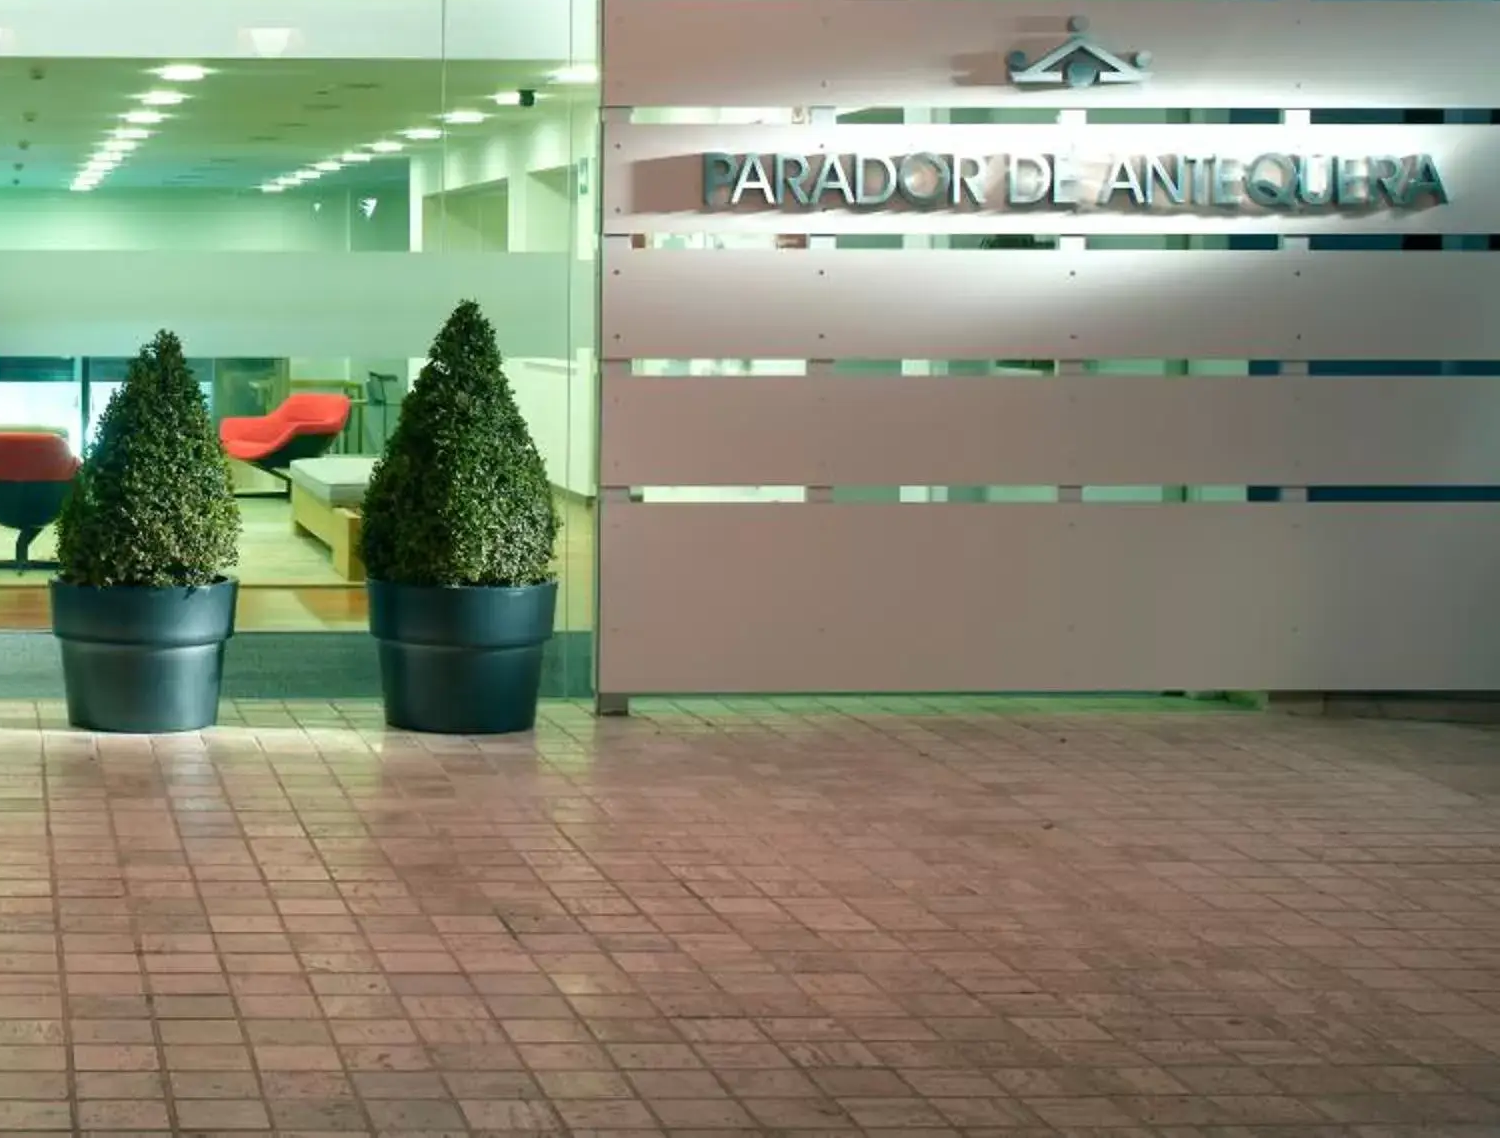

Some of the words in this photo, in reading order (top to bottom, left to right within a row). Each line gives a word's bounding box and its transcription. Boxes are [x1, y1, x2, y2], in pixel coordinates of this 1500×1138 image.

[703, 151, 985, 208] PARADOR
[1008, 153, 1084, 207] DE
[1101, 152, 1450, 208] ANTEQUERA
